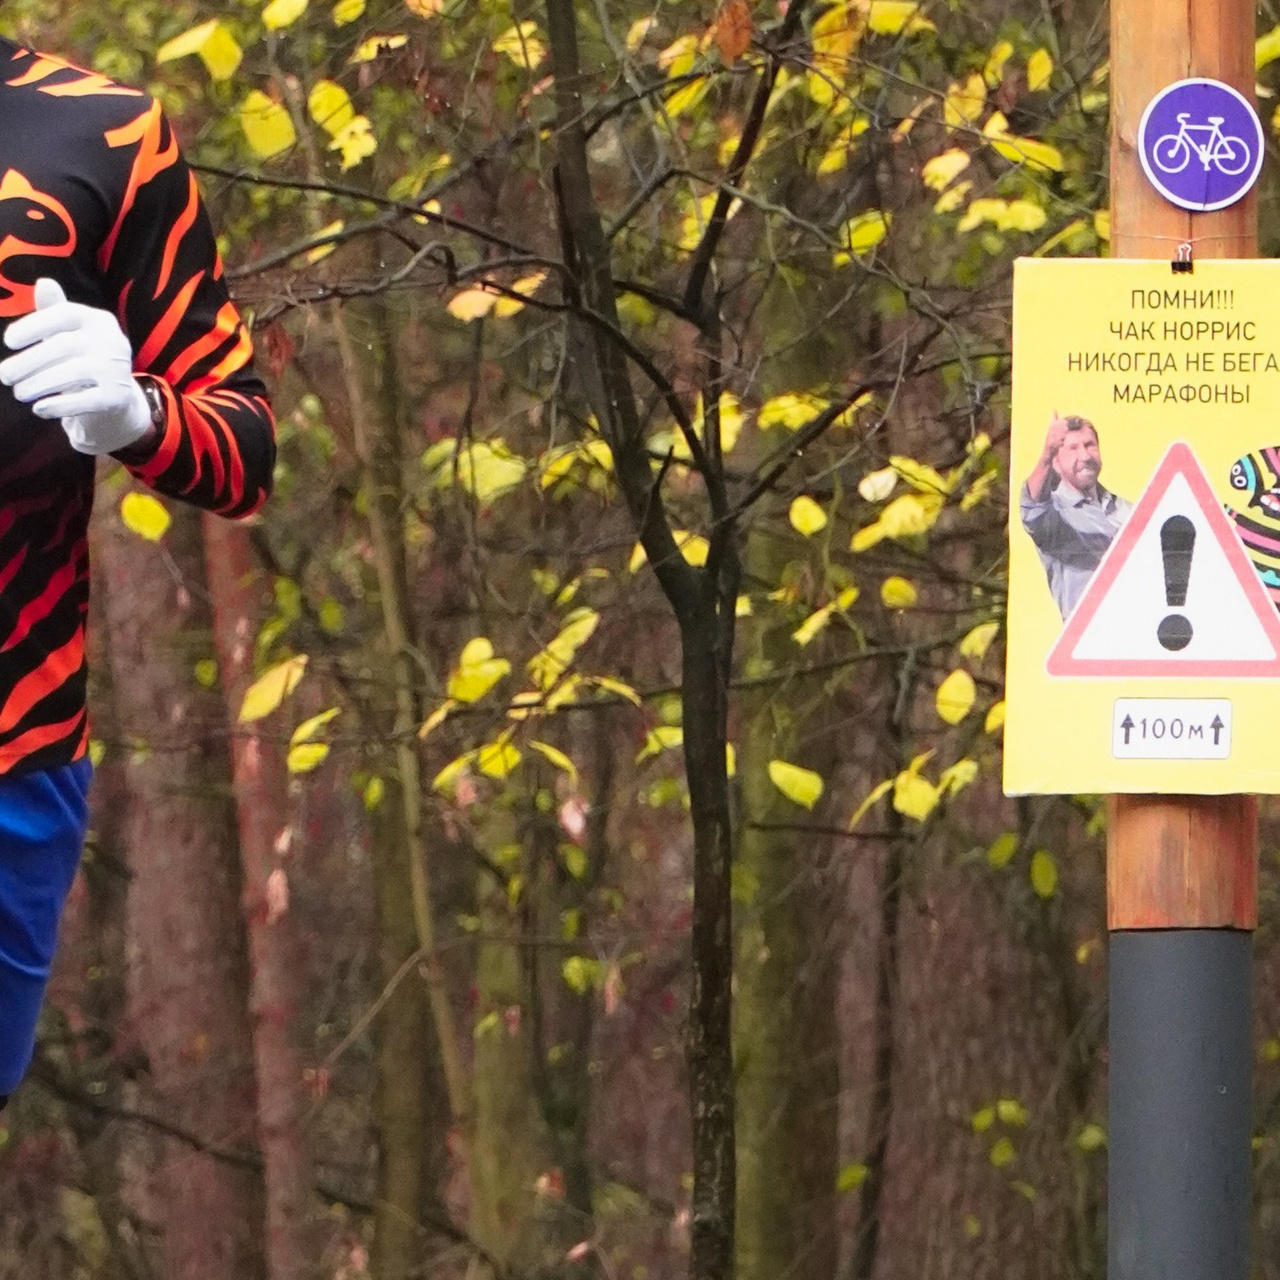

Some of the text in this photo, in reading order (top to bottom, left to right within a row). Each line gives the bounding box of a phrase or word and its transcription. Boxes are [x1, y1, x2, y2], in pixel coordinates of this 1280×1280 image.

[1131, 289, 1234, 310] ПОМНИ!!!
[1110, 321, 1256, 341] ЧАК НОРРИС
[1069, 352, 1280, 376] НИКОГДА НЕ БЕГА
[1113, 383, 1250, 404] МАРАФОНЫ
